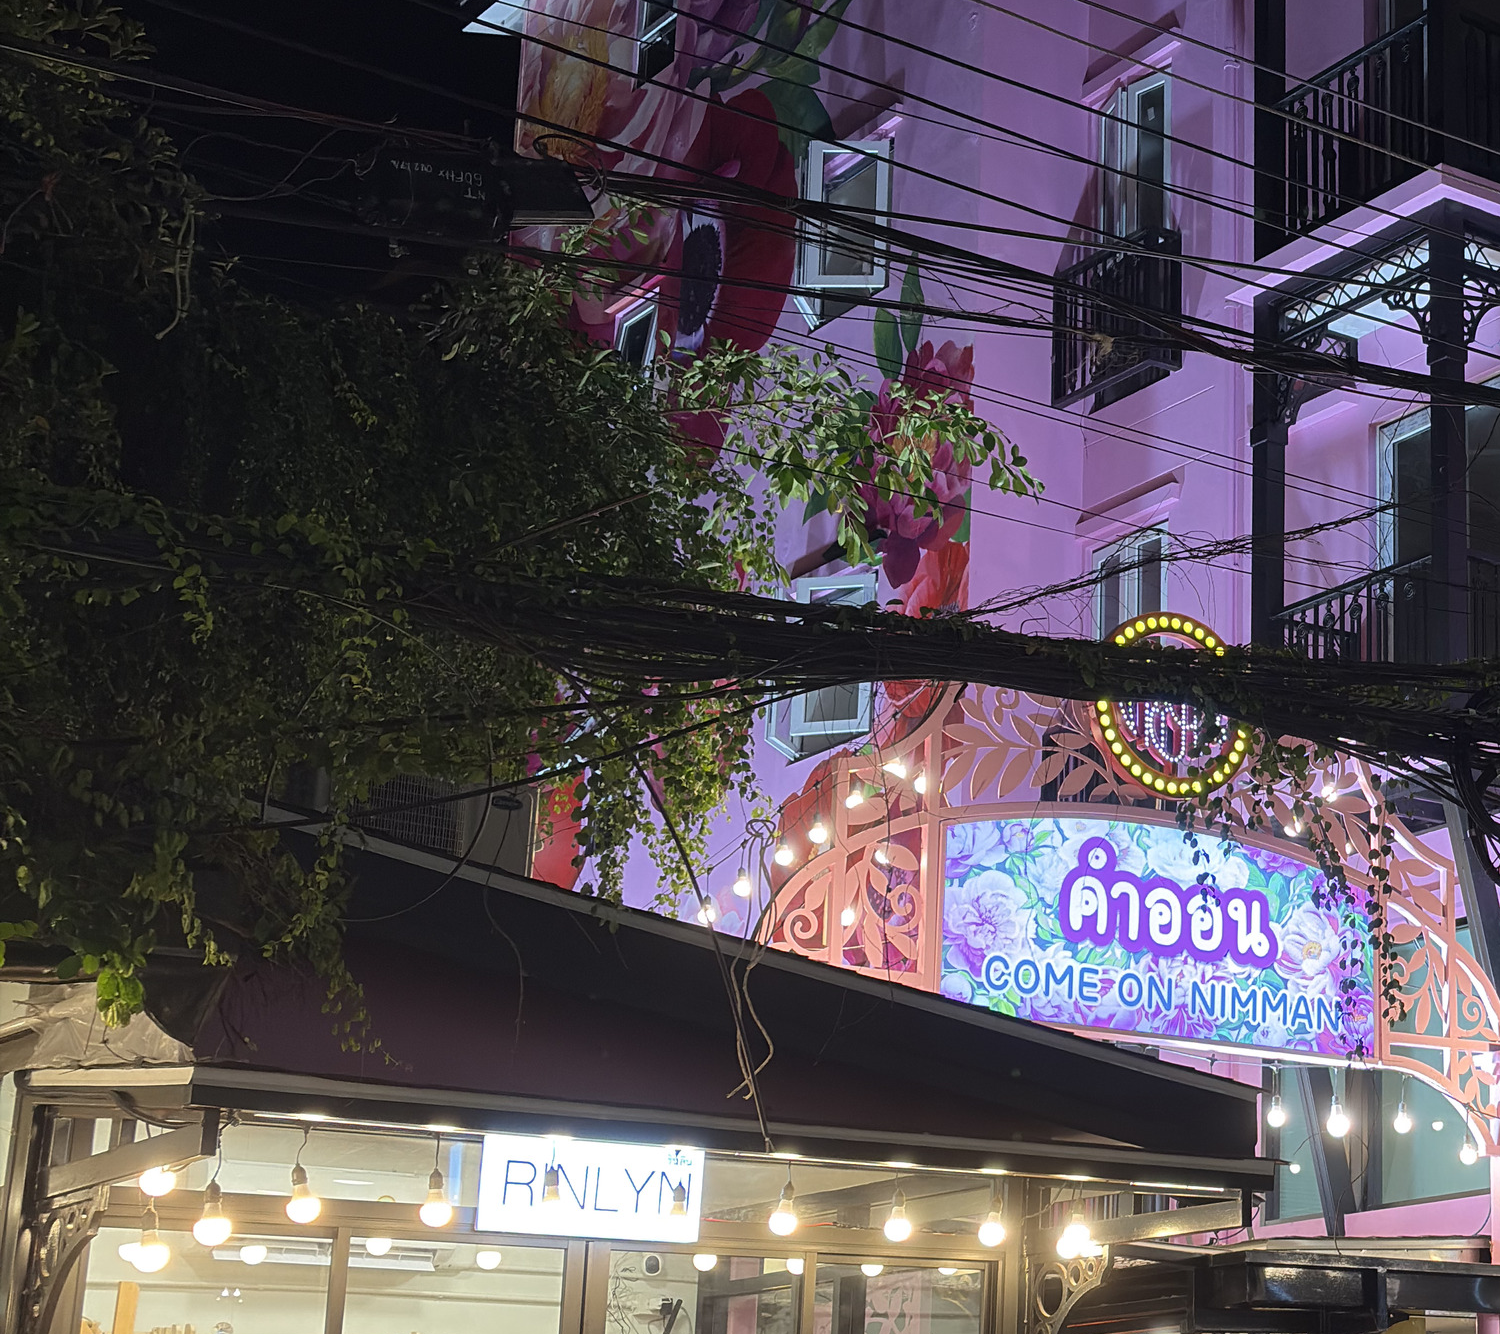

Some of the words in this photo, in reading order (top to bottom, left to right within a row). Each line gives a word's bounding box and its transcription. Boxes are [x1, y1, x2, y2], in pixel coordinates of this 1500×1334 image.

[1067, 844, 1272, 959] คำออน
[984, 954, 1100, 1003] COME
[1117, 972, 1173, 1012] ON
[1191, 980, 1341, 1032] NIMMAN
